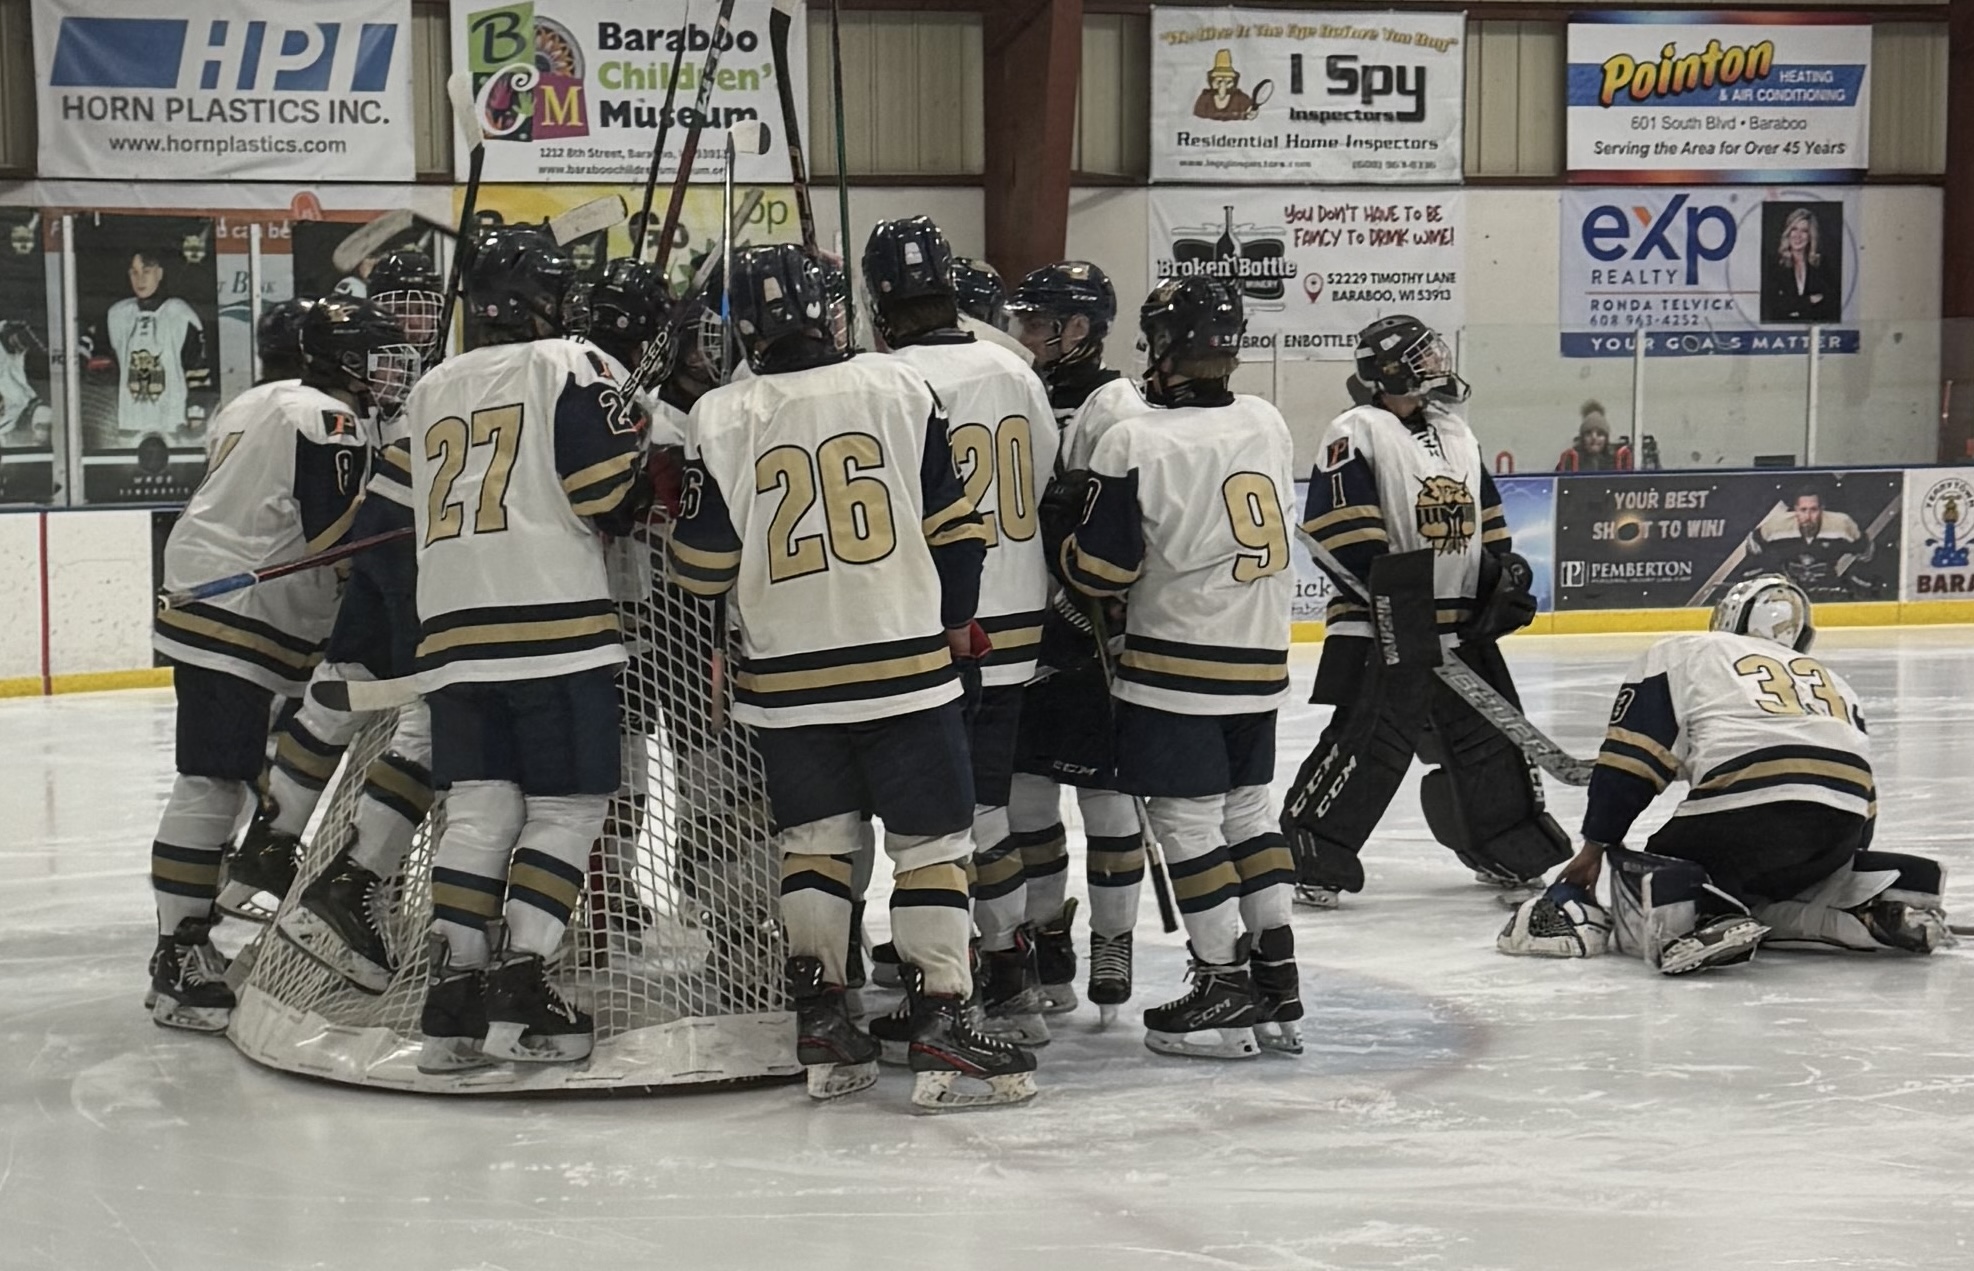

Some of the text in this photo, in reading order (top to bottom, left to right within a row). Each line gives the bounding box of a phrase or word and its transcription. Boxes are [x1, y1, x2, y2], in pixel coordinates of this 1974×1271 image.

[470, 11, 527, 65] B
[598, 22, 758, 52] Baraboo
[178, 18, 364, 92] HPI
[1600, 38, 1775, 108] Pointon
[1779, 70, 1834, 83] HEATING
[1290, 53, 1426, 122] I Spy
[1718, 88, 1846, 101] & AIR CONDITIONING
[62, 95, 391, 125] HORN PLASTICS INC.
[541, 85, 584, 127] M
[1289, 107, 1397, 124] Inspectors
[1630, 116, 1808, 130] 601 South Blvd Baraboo
[109, 135, 347, 156] www.hornplastics.com
[1177, 131, 1439, 152] Residential Home Inspectors
[1594, 140, 1847, 159] Serving the Area for Over 45 Years
[1426, 205, 1443, 223] BE
[1157, 255, 1298, 279] Broken Bottle
[1370, 272, 1424, 284] TIMOTHY
[1426, 271, 1457, 284] LANE
[1592, 269, 1679, 285] REALTY
[1332, 289, 1451, 303] BARABOO, WI 53913
[1590, 298, 1735, 311] RONDA TELVICK
[1590, 314, 1619, 327] 608
[425, 402, 525, 550] 27
[949, 414, 1037, 549] 20
[754, 431, 897, 585] 26
[1614, 490, 1709, 510] YOUR BEST
[1221, 470, 1290, 583] 9
[1658, 520, 1682, 539] TO
[1687, 519, 1726, 538] WIN!
[1591, 561, 1693, 577] PEMBERTON
[1733, 652, 1852, 726] 33
[1288, 743, 1339, 818] CCM
[1314, 754, 1358, 819] CCM
[1189, 999, 1232, 1028] CCM
